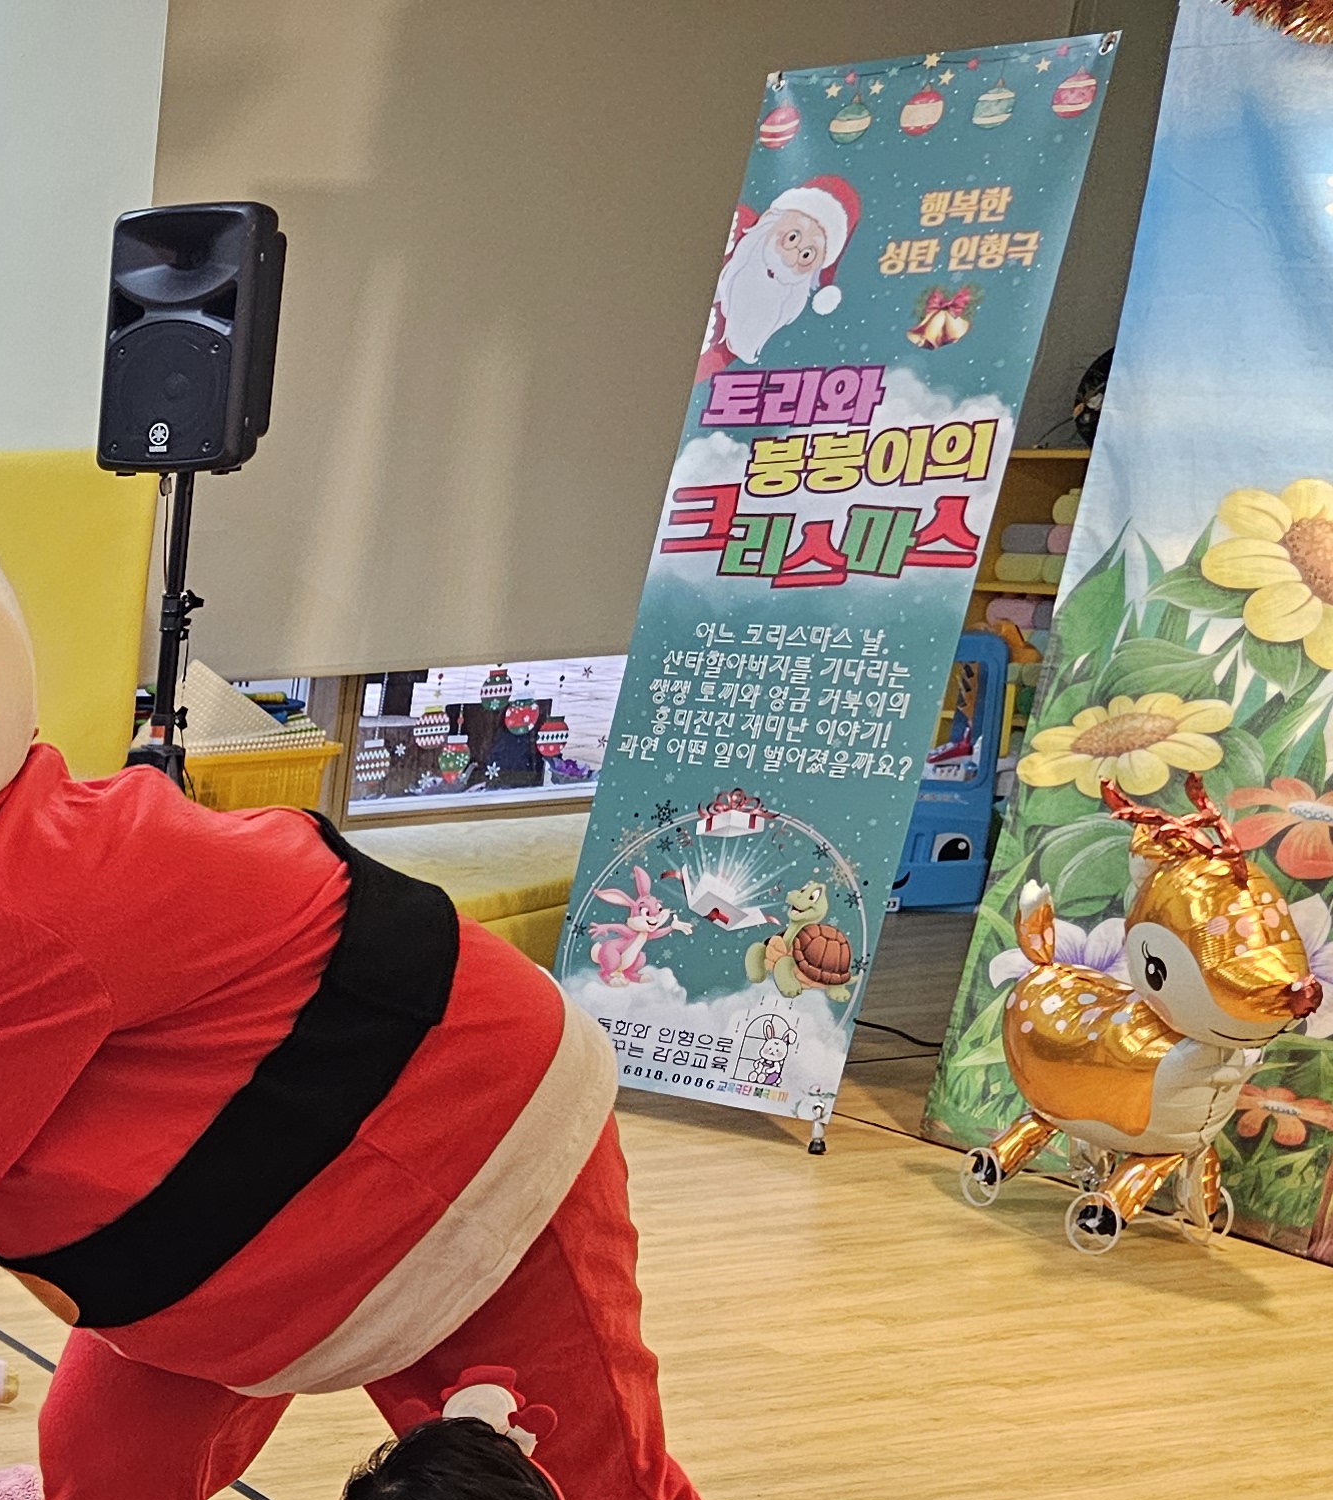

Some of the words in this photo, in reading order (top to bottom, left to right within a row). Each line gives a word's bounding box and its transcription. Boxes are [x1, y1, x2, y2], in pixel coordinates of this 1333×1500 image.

[919, 186, 1013, 227] 행복한
[879, 240, 939, 276] 성탄
[949, 230, 1039, 272] 인형극
[698, 366, 885, 430] 토리와
[744, 420, 1000, 498] 붕붕이의
[660, 482, 982, 589] 크리스마스
[695, 622, 735, 648] 어느
[741, 624, 853, 651] 크리스마스
[662, 650, 812, 685] 산타할아버지를
[819, 657, 911, 689] 기다리는
[649, 678, 691, 705] 쌩쌩
[695, 681, 761, 709] 토끼와
[768, 685, 811, 712] 엉금
[818, 688, 911, 720] 거북이의
[651, 706, 735, 738] 흥미진진
[740, 713, 809, 743] 재미난
[815, 719, 892, 748] 이야기!
[617, 733, 659, 761] 과연
[666, 738, 708, 765] 어떤
[714, 743, 756, 769] 일이
[763, 748, 913, 782] 벌어졌을까요?
[653, 1046, 729, 1073] 감성교육
[658, 1027, 733, 1054] 인형으로
